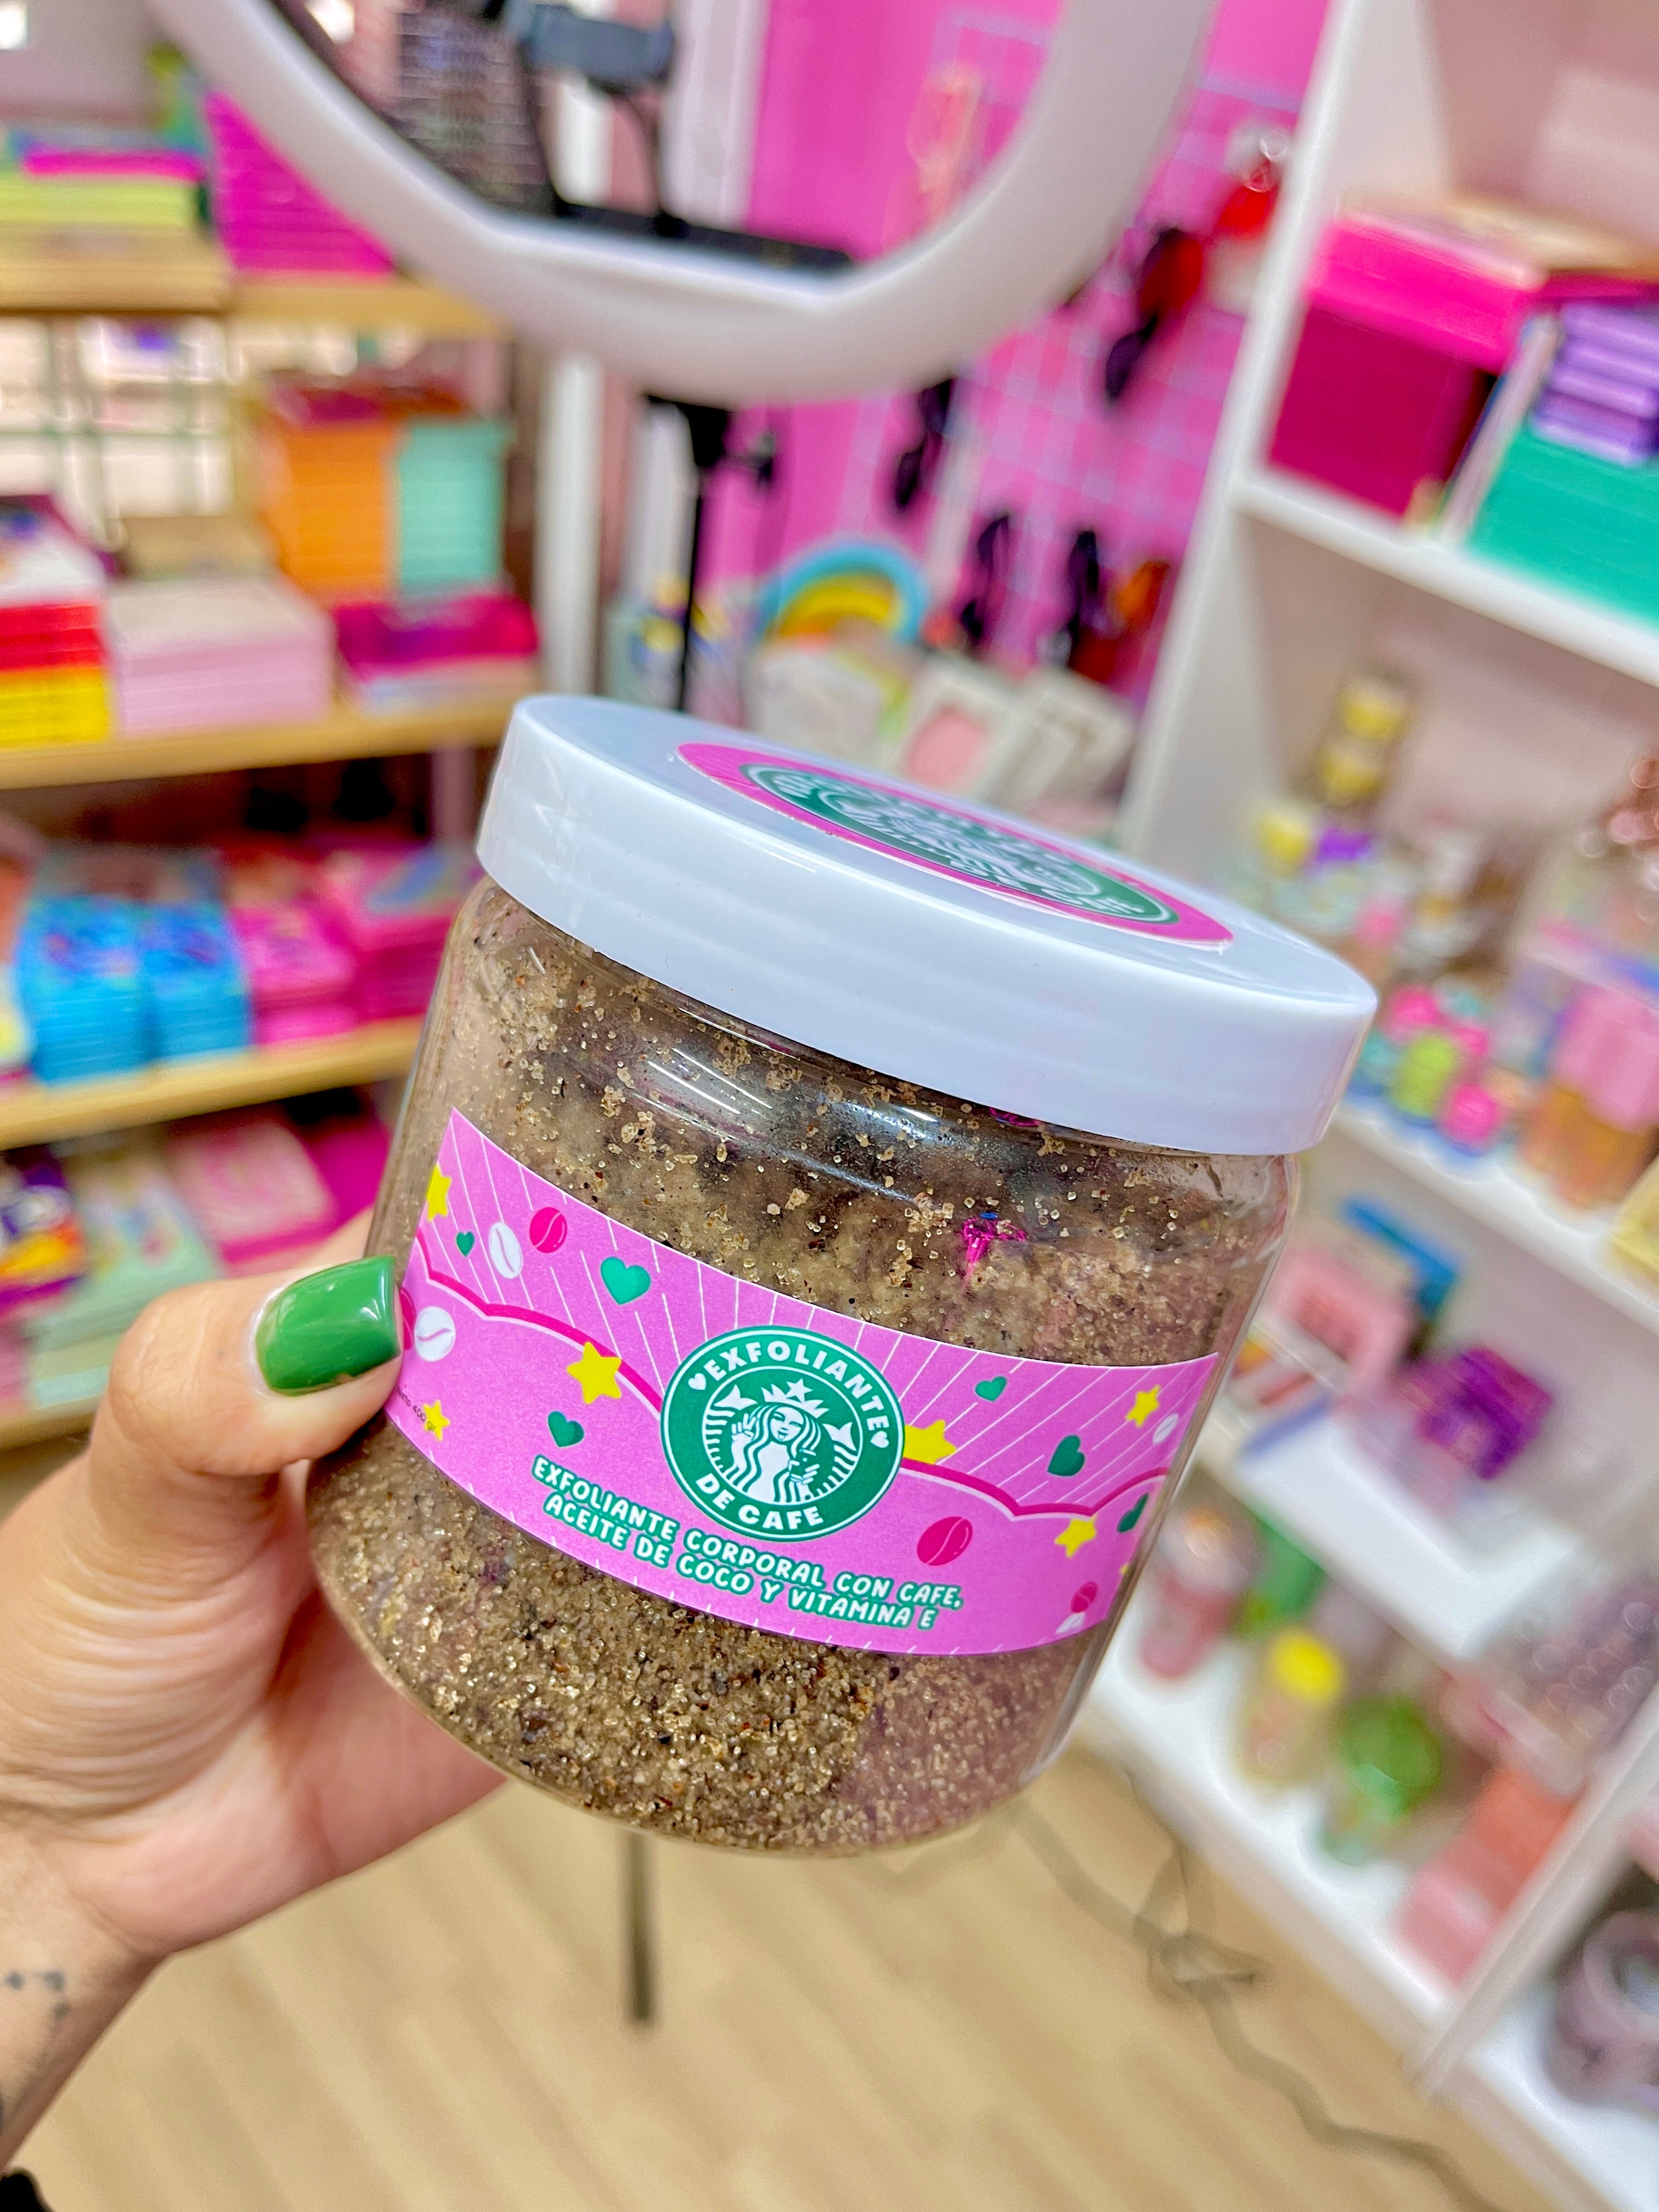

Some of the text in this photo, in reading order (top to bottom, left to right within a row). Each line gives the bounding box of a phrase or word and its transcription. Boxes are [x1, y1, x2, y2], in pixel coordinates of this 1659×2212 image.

[703, 1340, 890, 1431] EXFOLIANTE
[534, 1456, 678, 1543] EXFOLIANTE
[686, 1530, 823, 1587] CORPORAL
[836, 1573, 891, 1598] CON
[696, 1473, 824, 1530] DE CAFE
[545, 1494, 936, 1628] ACEITE DE COCO Y VITAMINA E
